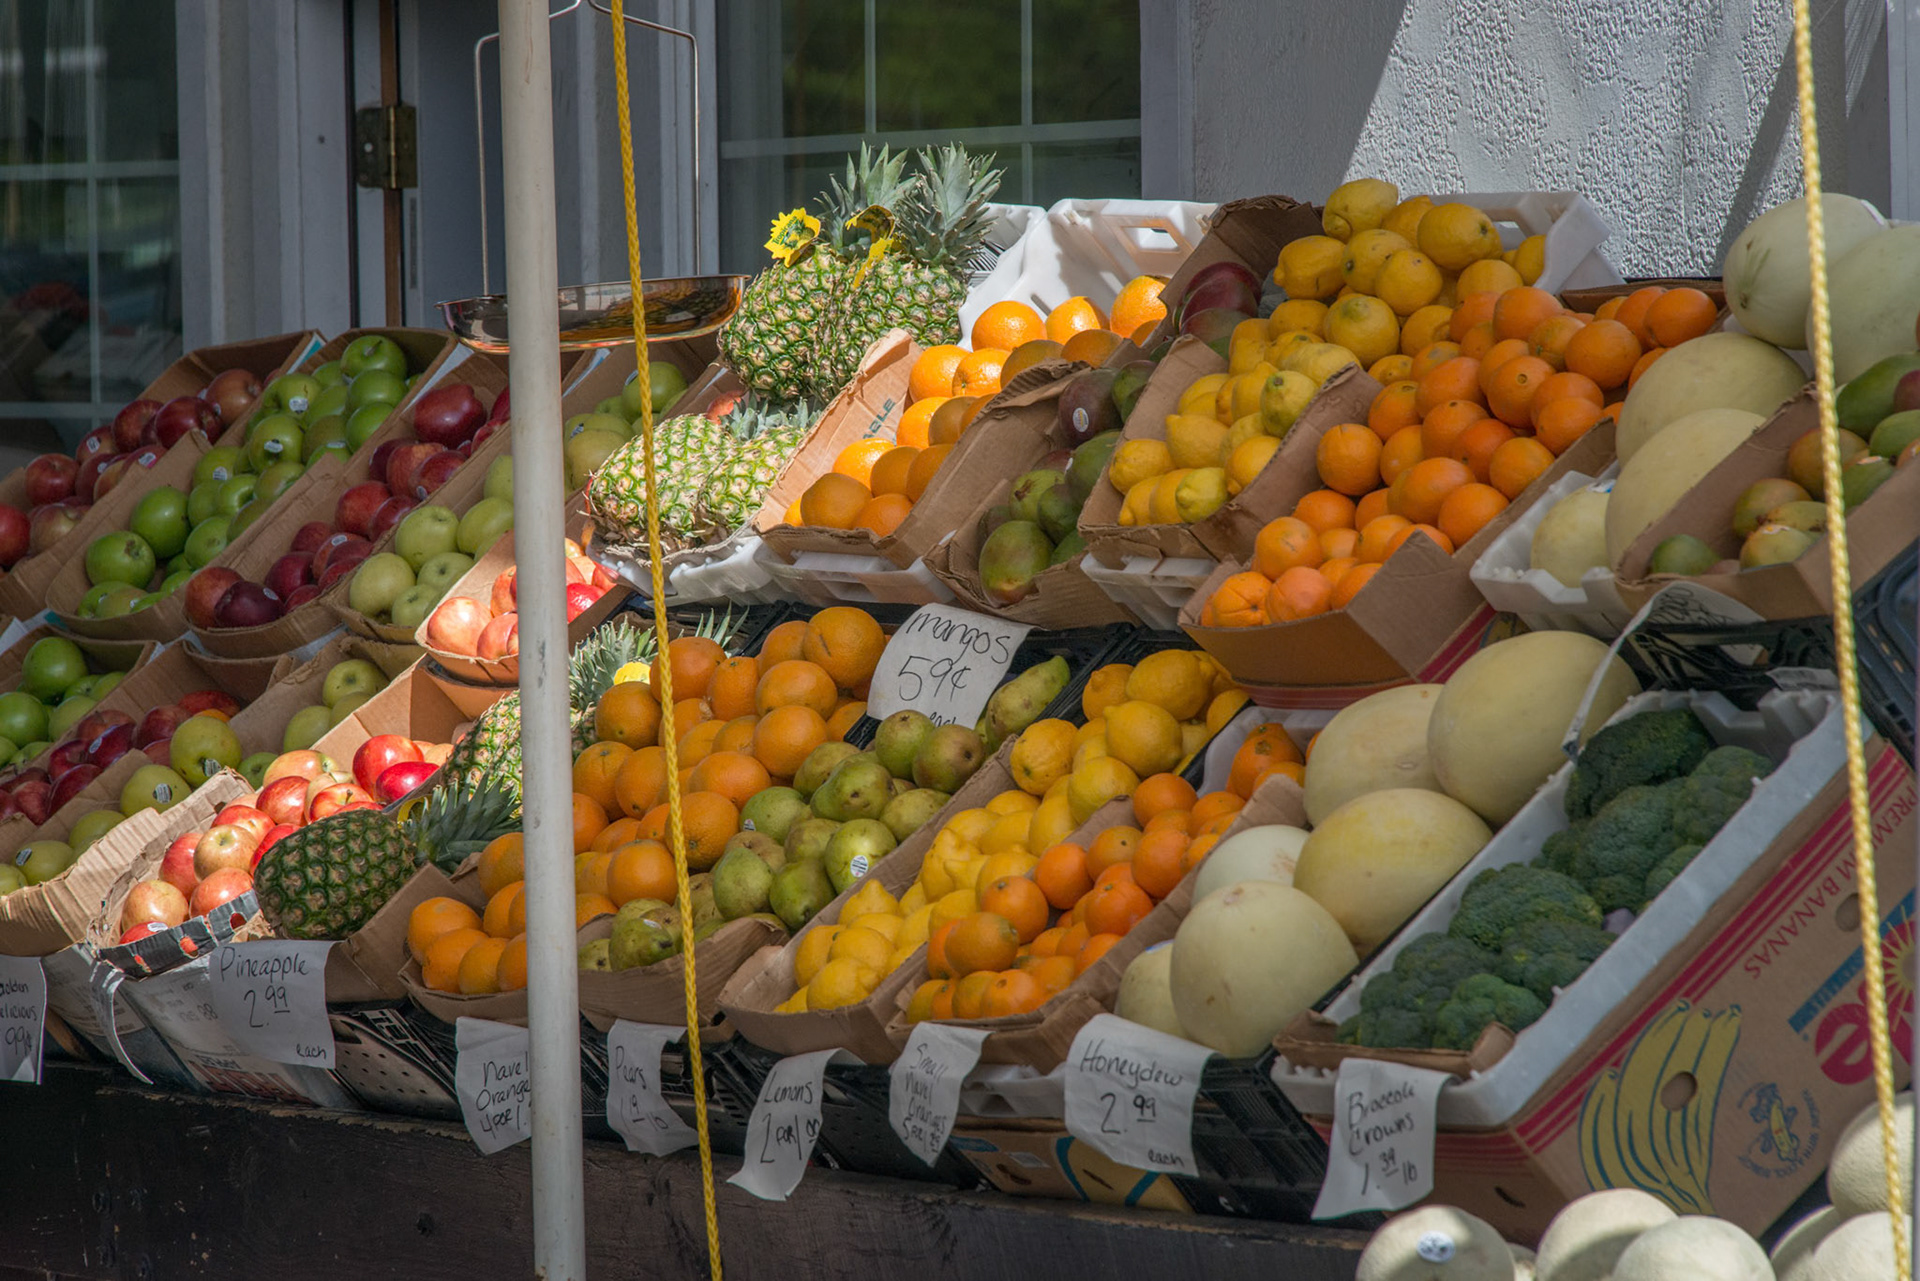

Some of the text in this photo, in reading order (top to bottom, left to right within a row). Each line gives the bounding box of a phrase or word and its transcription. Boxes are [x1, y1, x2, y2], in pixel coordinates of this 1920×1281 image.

[897, 655, 972, 702] 59¢
[1744, 877, 1841, 980] BANANAS
[219, 945, 310, 984] Pineapple
[0, 1003, 38, 1022] elicious
[296, 1043, 327, 1060] each
[615, 1045, 648, 1090] Pears
[909, 1042, 949, 1085] Small
[1079, 1038, 1184, 1091] Honeydew
[475, 1079, 533, 1112] Orange
[764, 1070, 813, 1105] Lemons
[1348, 1111, 1415, 1157] Crowns
[1148, 1148, 1185, 1168] each
